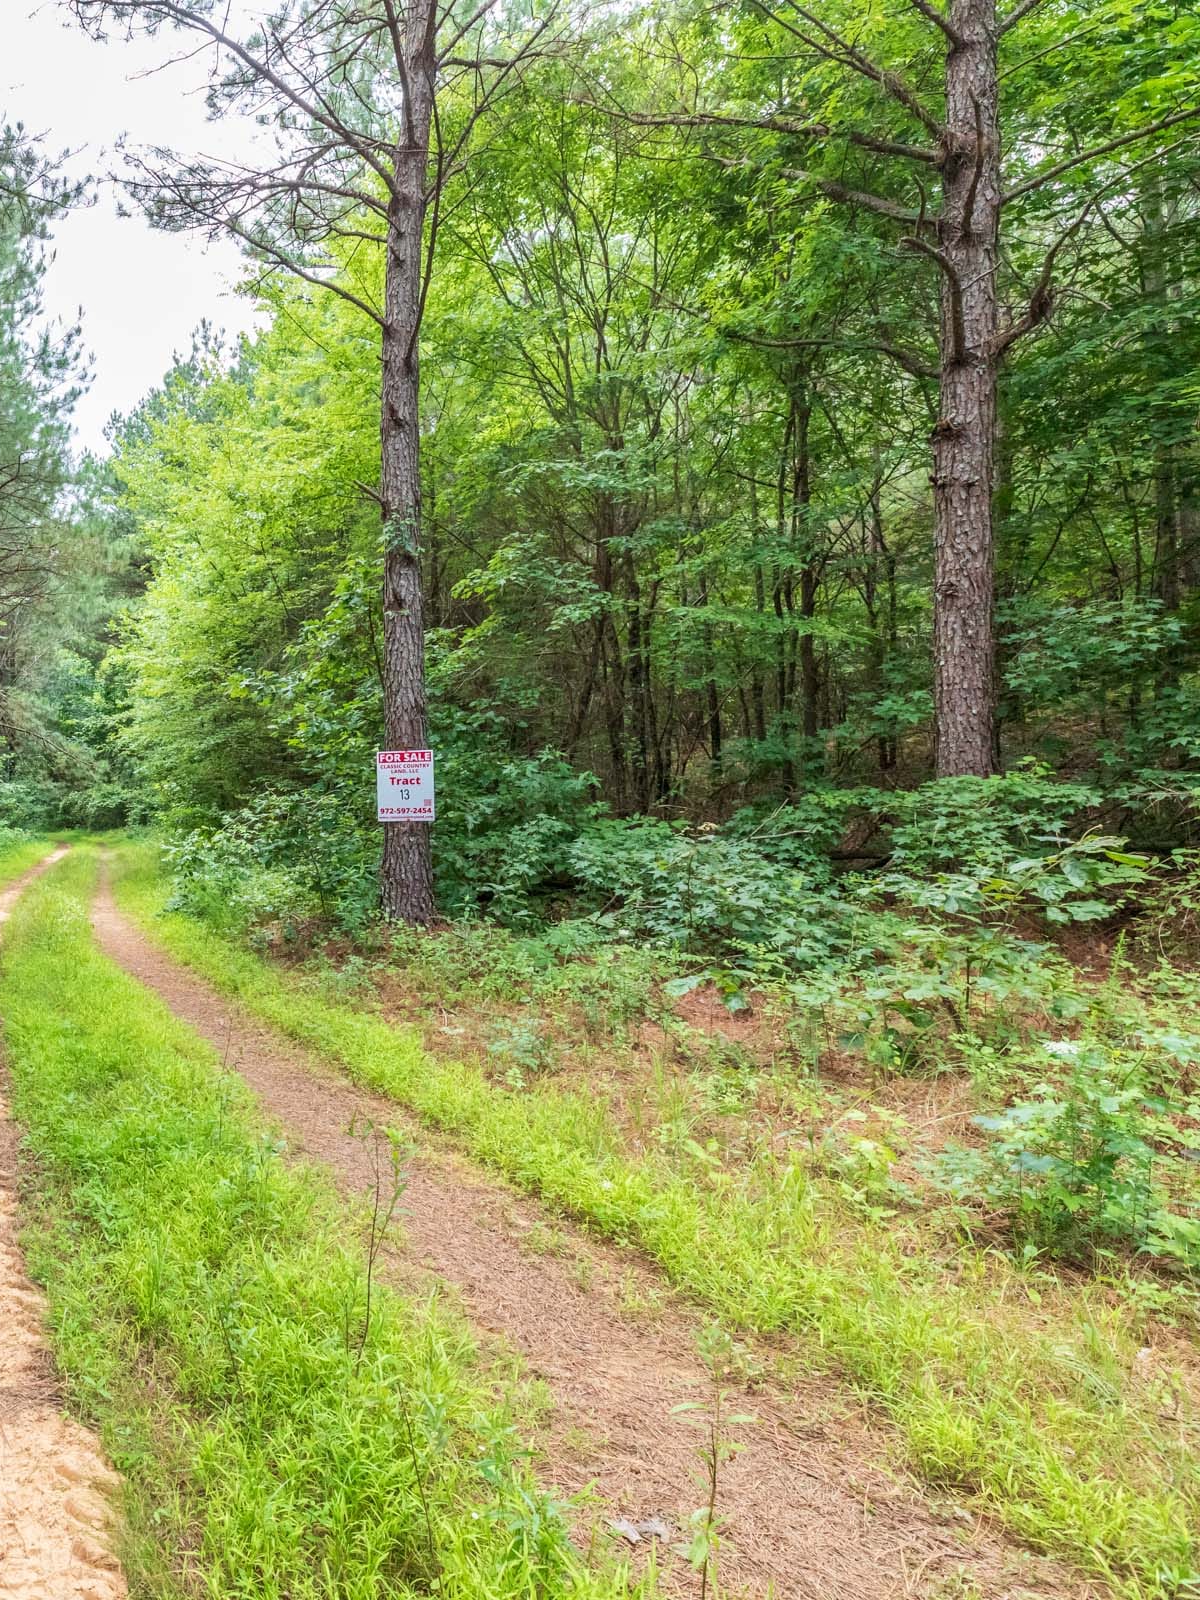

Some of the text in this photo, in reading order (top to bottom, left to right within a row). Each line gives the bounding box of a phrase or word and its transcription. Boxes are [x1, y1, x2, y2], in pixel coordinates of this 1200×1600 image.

[380, 753, 430, 762] FOR SALE
[389, 777, 421, 785] Tract
[400, 789, 410, 800] 13
